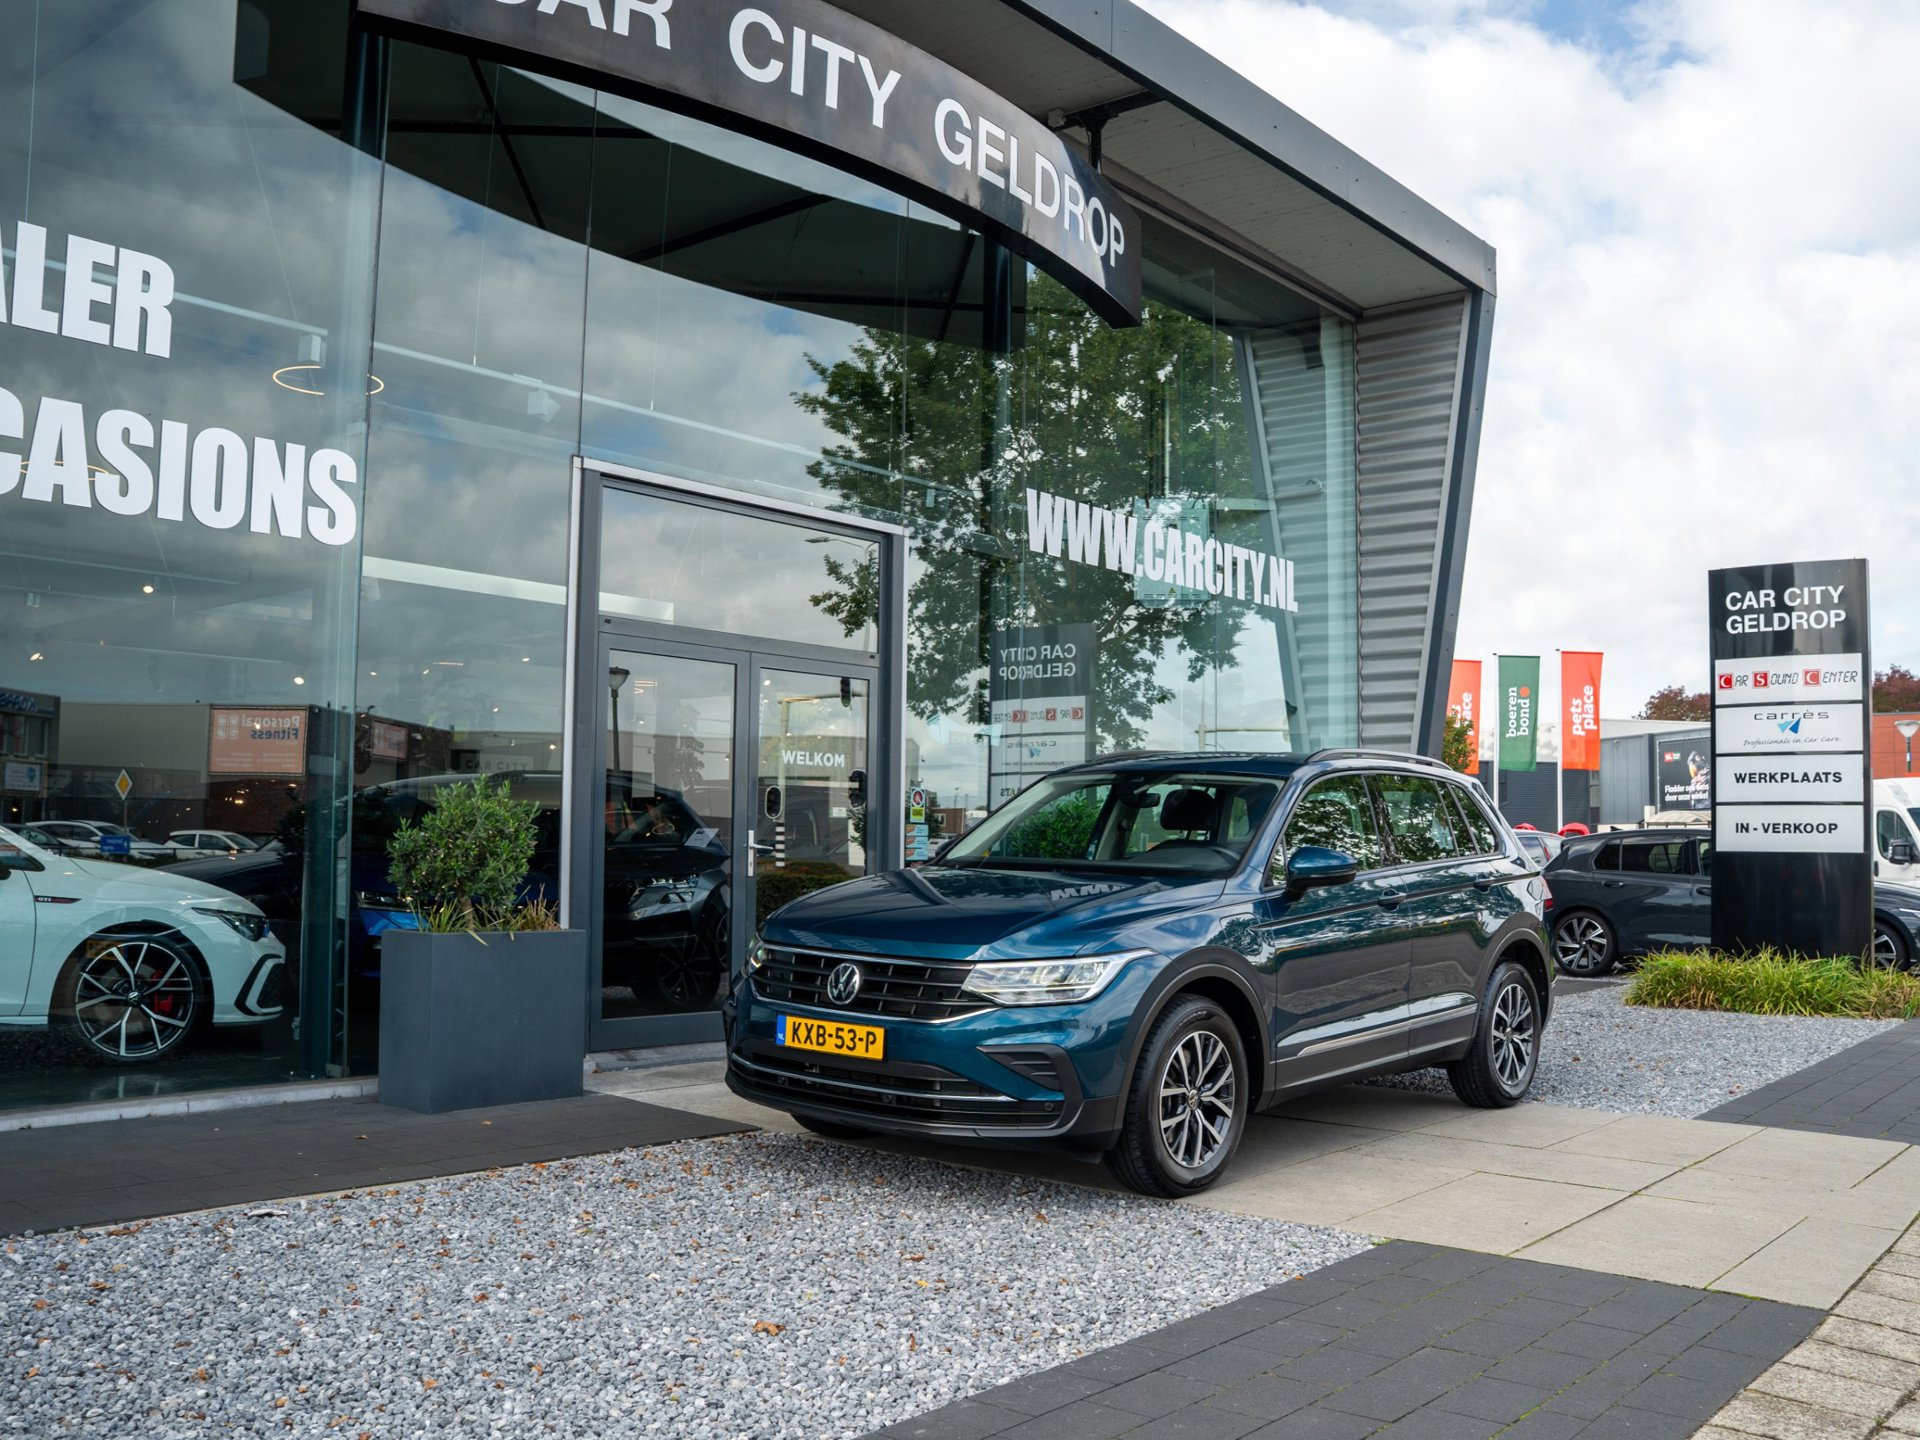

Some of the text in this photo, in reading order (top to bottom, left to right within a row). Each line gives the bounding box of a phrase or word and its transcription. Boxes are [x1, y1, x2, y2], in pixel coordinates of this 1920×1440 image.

[728, 8, 1125, 267] CITY GELDROP
[0, 221, 174, 359] LER
[1026, 487, 1299, 613] WWW.CARCITY.NL
[1725, 585, 1845, 611] CAR CITY
[1726, 609, 1847, 635] GELDROP
[1719, 669, 1858, 689] CAR SOUND CENTER
[1506, 686, 1518, 738] boeren
[1517, 698, 1530, 736] bond
[1570, 697, 1586, 737] pets
[1582, 685, 1598, 730] place
[1754, 710, 1829, 721] carrès
[1743, 737, 1790, 748] Professionals
[781, 750, 845, 768] WELKOM
[1734, 771, 1843, 784] WERKPLAATS
[777, 1032, 785, 1041] NL
[791, 1021, 877, 1053] KXB-53-P
